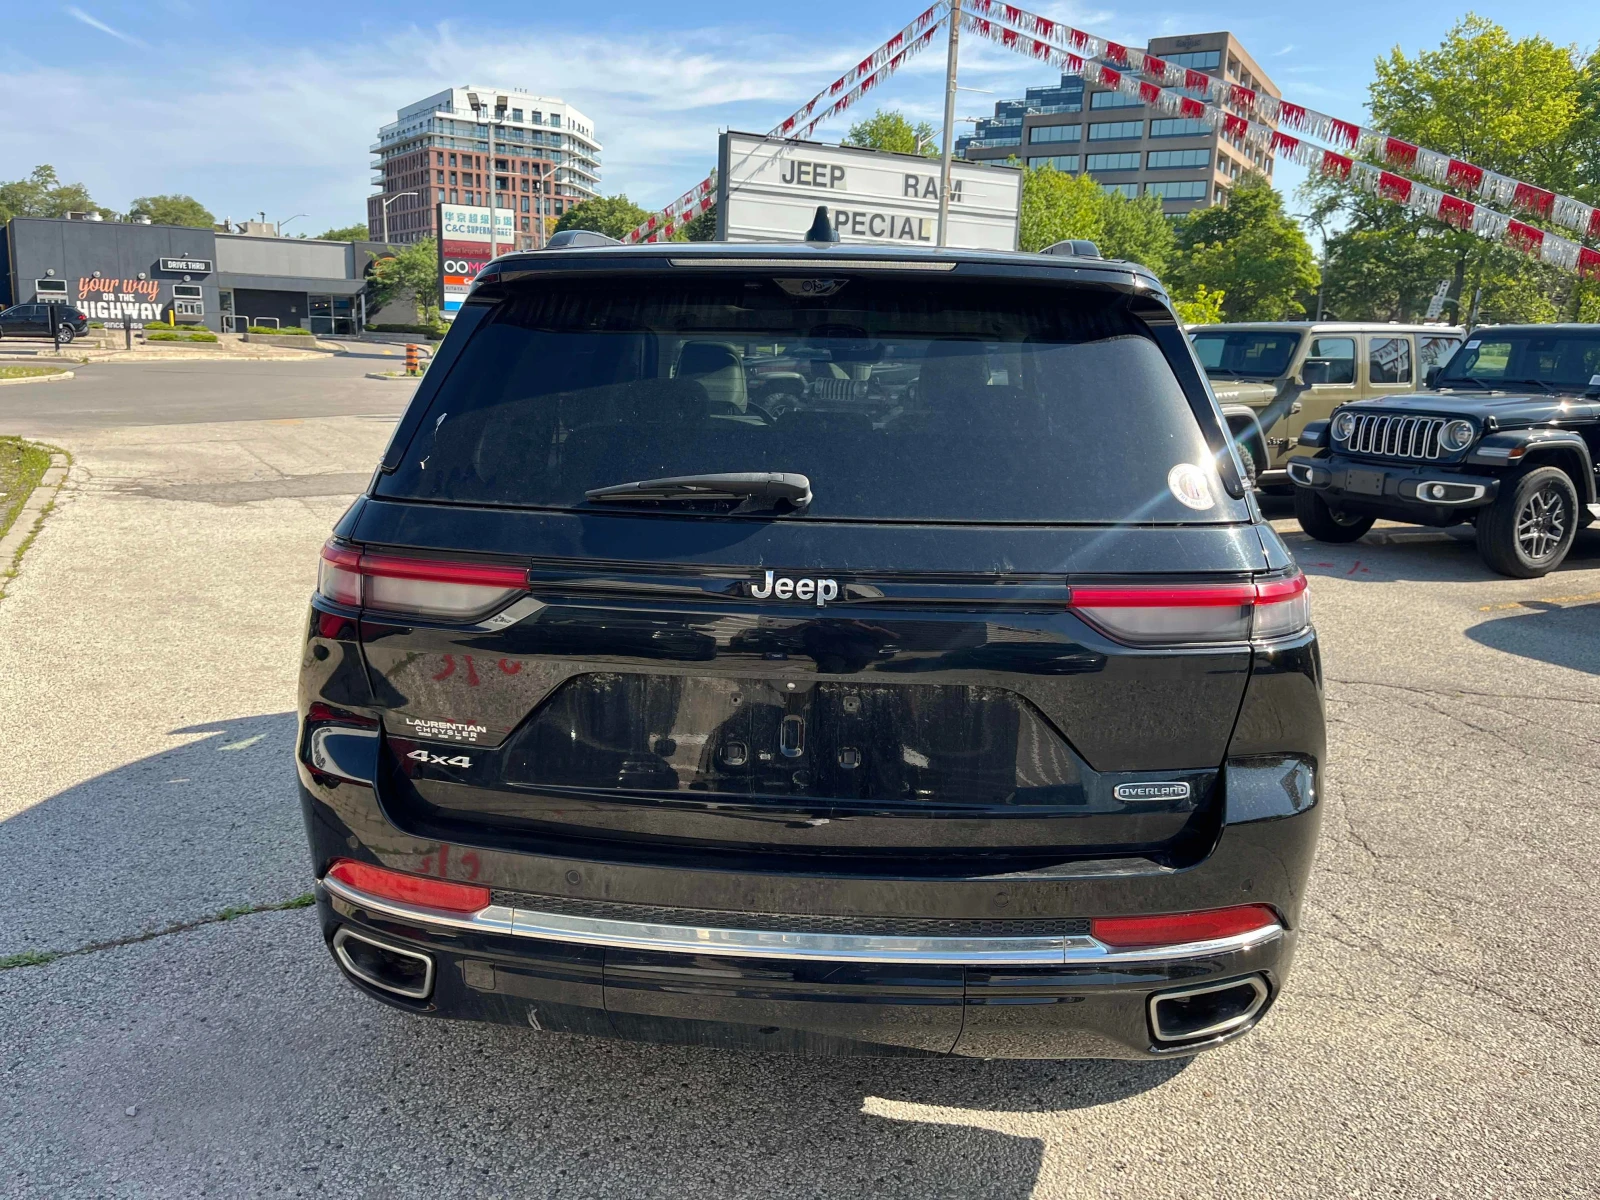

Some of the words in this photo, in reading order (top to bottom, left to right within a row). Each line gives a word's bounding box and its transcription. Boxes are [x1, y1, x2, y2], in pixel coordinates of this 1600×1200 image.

[782, 160, 846, 188] JEEP
[904, 174, 962, 202] RAM
[445, 223, 465, 232] C&C
[467, 225, 511, 236] SUPERMRKET
[834, 210, 930, 241] PECIAL
[168, 260, 187, 269] DRIVE
[188, 261, 205, 270] THRU
[78, 277, 118, 299] your
[123, 280, 160, 302] way
[102, 292, 115, 301] OR
[118, 293, 135, 302] THE
[76, 300, 163, 321] HIGHWAY
[751, 570, 838, 606] Jeep
[406, 717, 487, 733] LAURENTIAN
[415, 726, 478, 738] CHRYSLER
[406, 749, 473, 769] 4x4
[1119, 786, 1187, 796] OVERLAND
